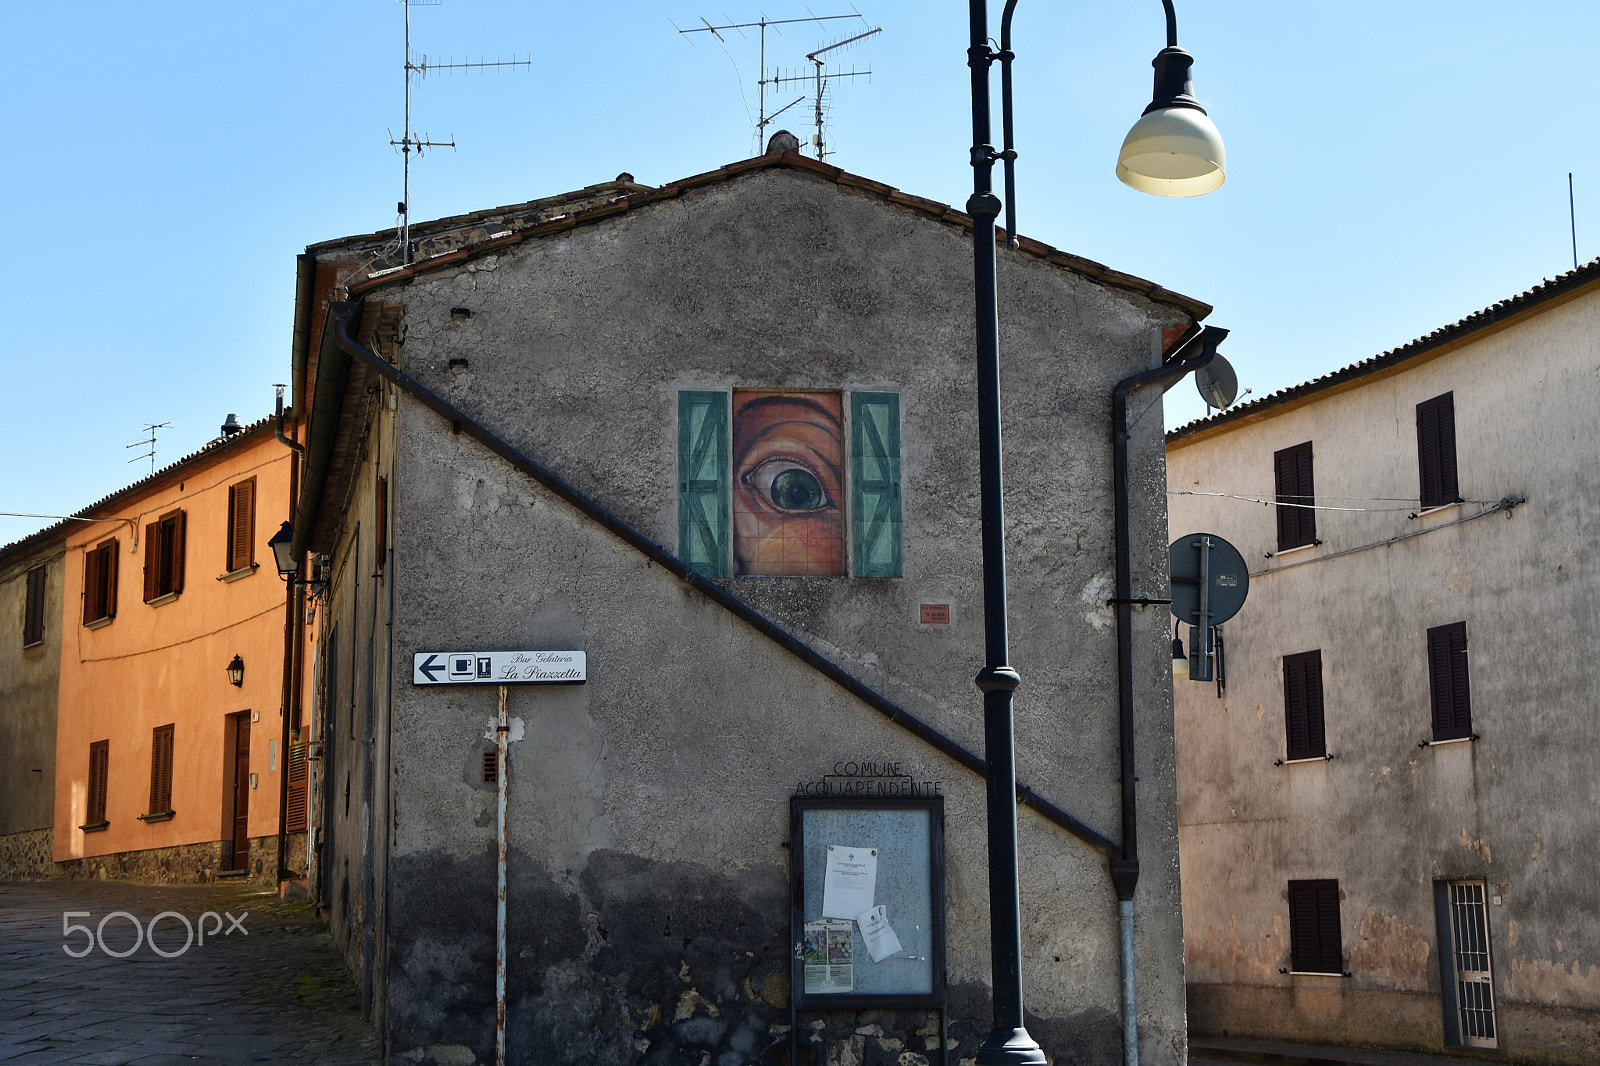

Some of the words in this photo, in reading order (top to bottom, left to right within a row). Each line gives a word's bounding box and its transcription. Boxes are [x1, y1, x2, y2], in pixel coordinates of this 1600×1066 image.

[480, 659, 489, 673] T
[511, 654, 533, 664] Bar
[536, 653, 574, 664] Gelateria
[498, 665, 519, 680] La
[523, 666, 582, 680] Piazzetta
[833, 762, 902, 777] COMUNE
[795, 781, 942, 797] ACQUAPENDENTE
